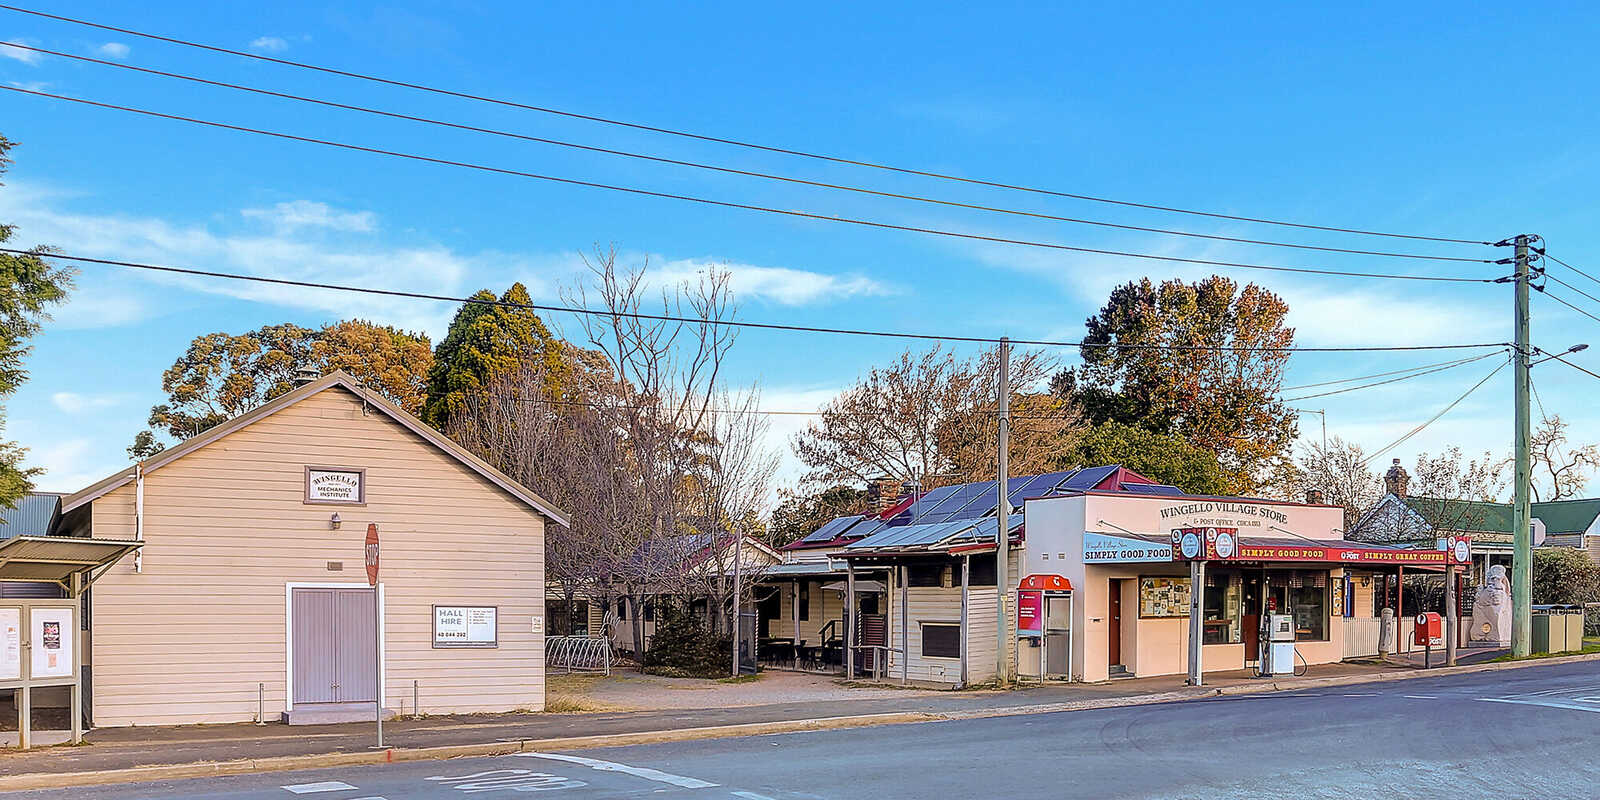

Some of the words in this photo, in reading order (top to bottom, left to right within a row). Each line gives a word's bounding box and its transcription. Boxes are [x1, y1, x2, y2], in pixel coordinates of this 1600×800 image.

[313, 475, 357, 487] WINGELLO
[1160, 502, 1213, 519] WINGELLO
[1215, 503, 1257, 516] VILLAGE
[1259, 507, 1288, 524] STORE
[1215, 518, 1234, 526] OFFICE
[366, 543, 379, 566] STOP
[1085, 550, 1118, 560] SIMPLY
[1120, 550, 1145, 559] GOOD
[1147, 549, 1171, 558] FOOD
[1241, 549, 1275, 557] SIMPLY
[1277, 549, 1300, 557] GOOD
[1302, 550, 1324, 558] FOOD
[1346, 551, 1359, 560] POST
[1419, 553, 1444, 561] COFFEE
